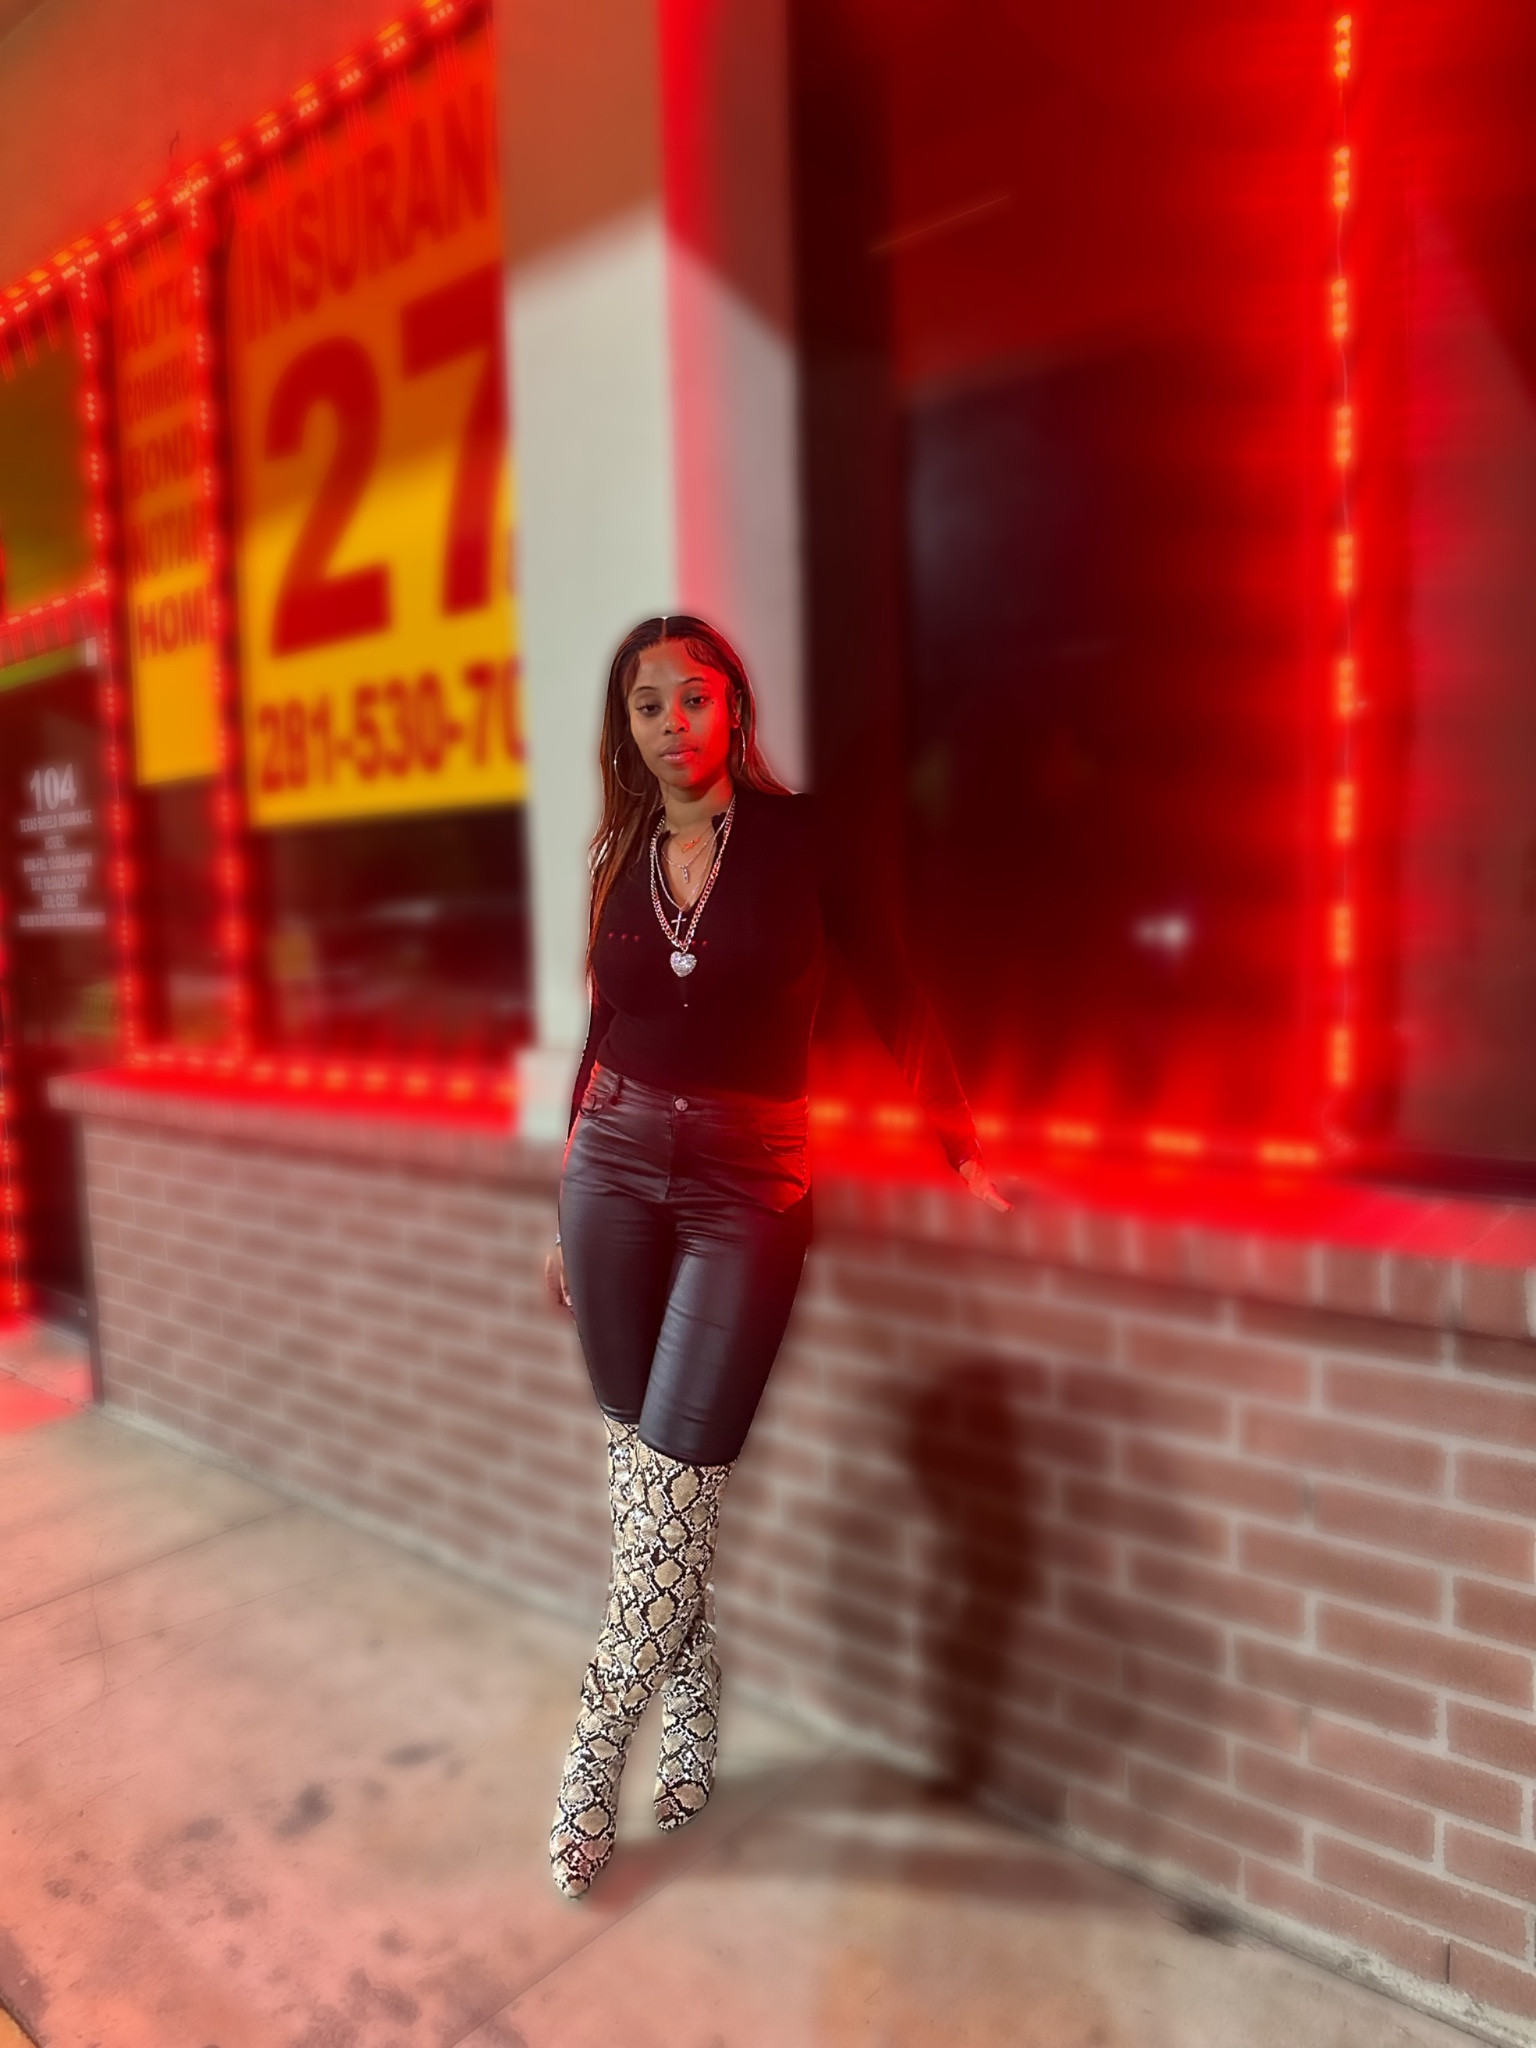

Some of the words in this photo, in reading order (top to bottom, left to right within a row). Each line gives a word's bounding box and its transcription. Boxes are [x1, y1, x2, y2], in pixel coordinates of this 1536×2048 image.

[241, 78, 498, 350] INSURAN
[121, 270, 196, 359] AUTO
[130, 499, 208, 584] NOTAR
[30, 763, 77, 812] 104
[58, 808, 93, 828] INSURANCE
